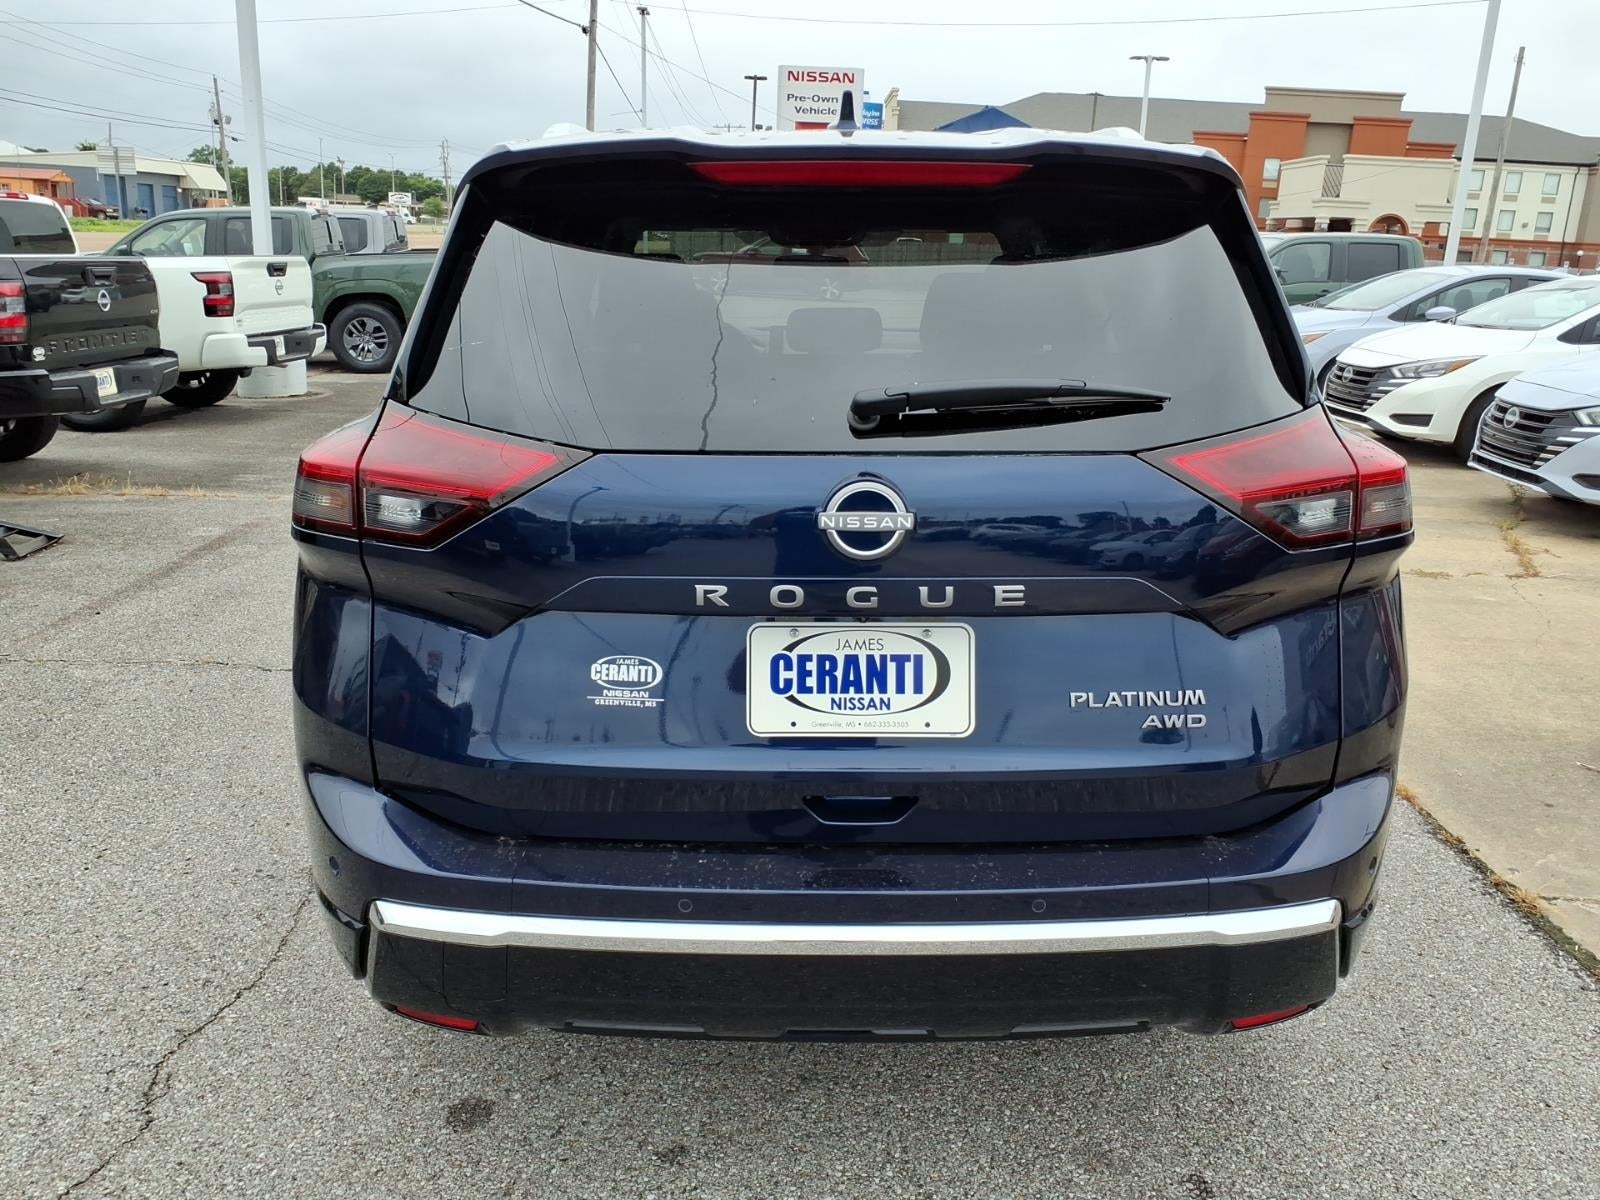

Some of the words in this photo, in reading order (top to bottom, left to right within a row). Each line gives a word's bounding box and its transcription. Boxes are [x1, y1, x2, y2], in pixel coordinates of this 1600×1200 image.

[787, 70, 855, 84] NISSAN
[786, 93, 839, 103] Pre-Own
[794, 106, 838, 115] Vehicle
[820, 516, 912, 528] NISSAN
[694, 584, 1027, 608] ROGUE
[835, 638, 885, 651] JAMES
[590, 663, 654, 682] CERANTI
[769, 652, 924, 696] CERANTI
[602, 689, 649, 698] NISSAN
[1070, 689, 1207, 708] PLATINUM
[594, 698, 644, 708] GREENVILLE,
[830, 696, 891, 711] NISSAN
[1141, 714, 1207, 729] AWD
